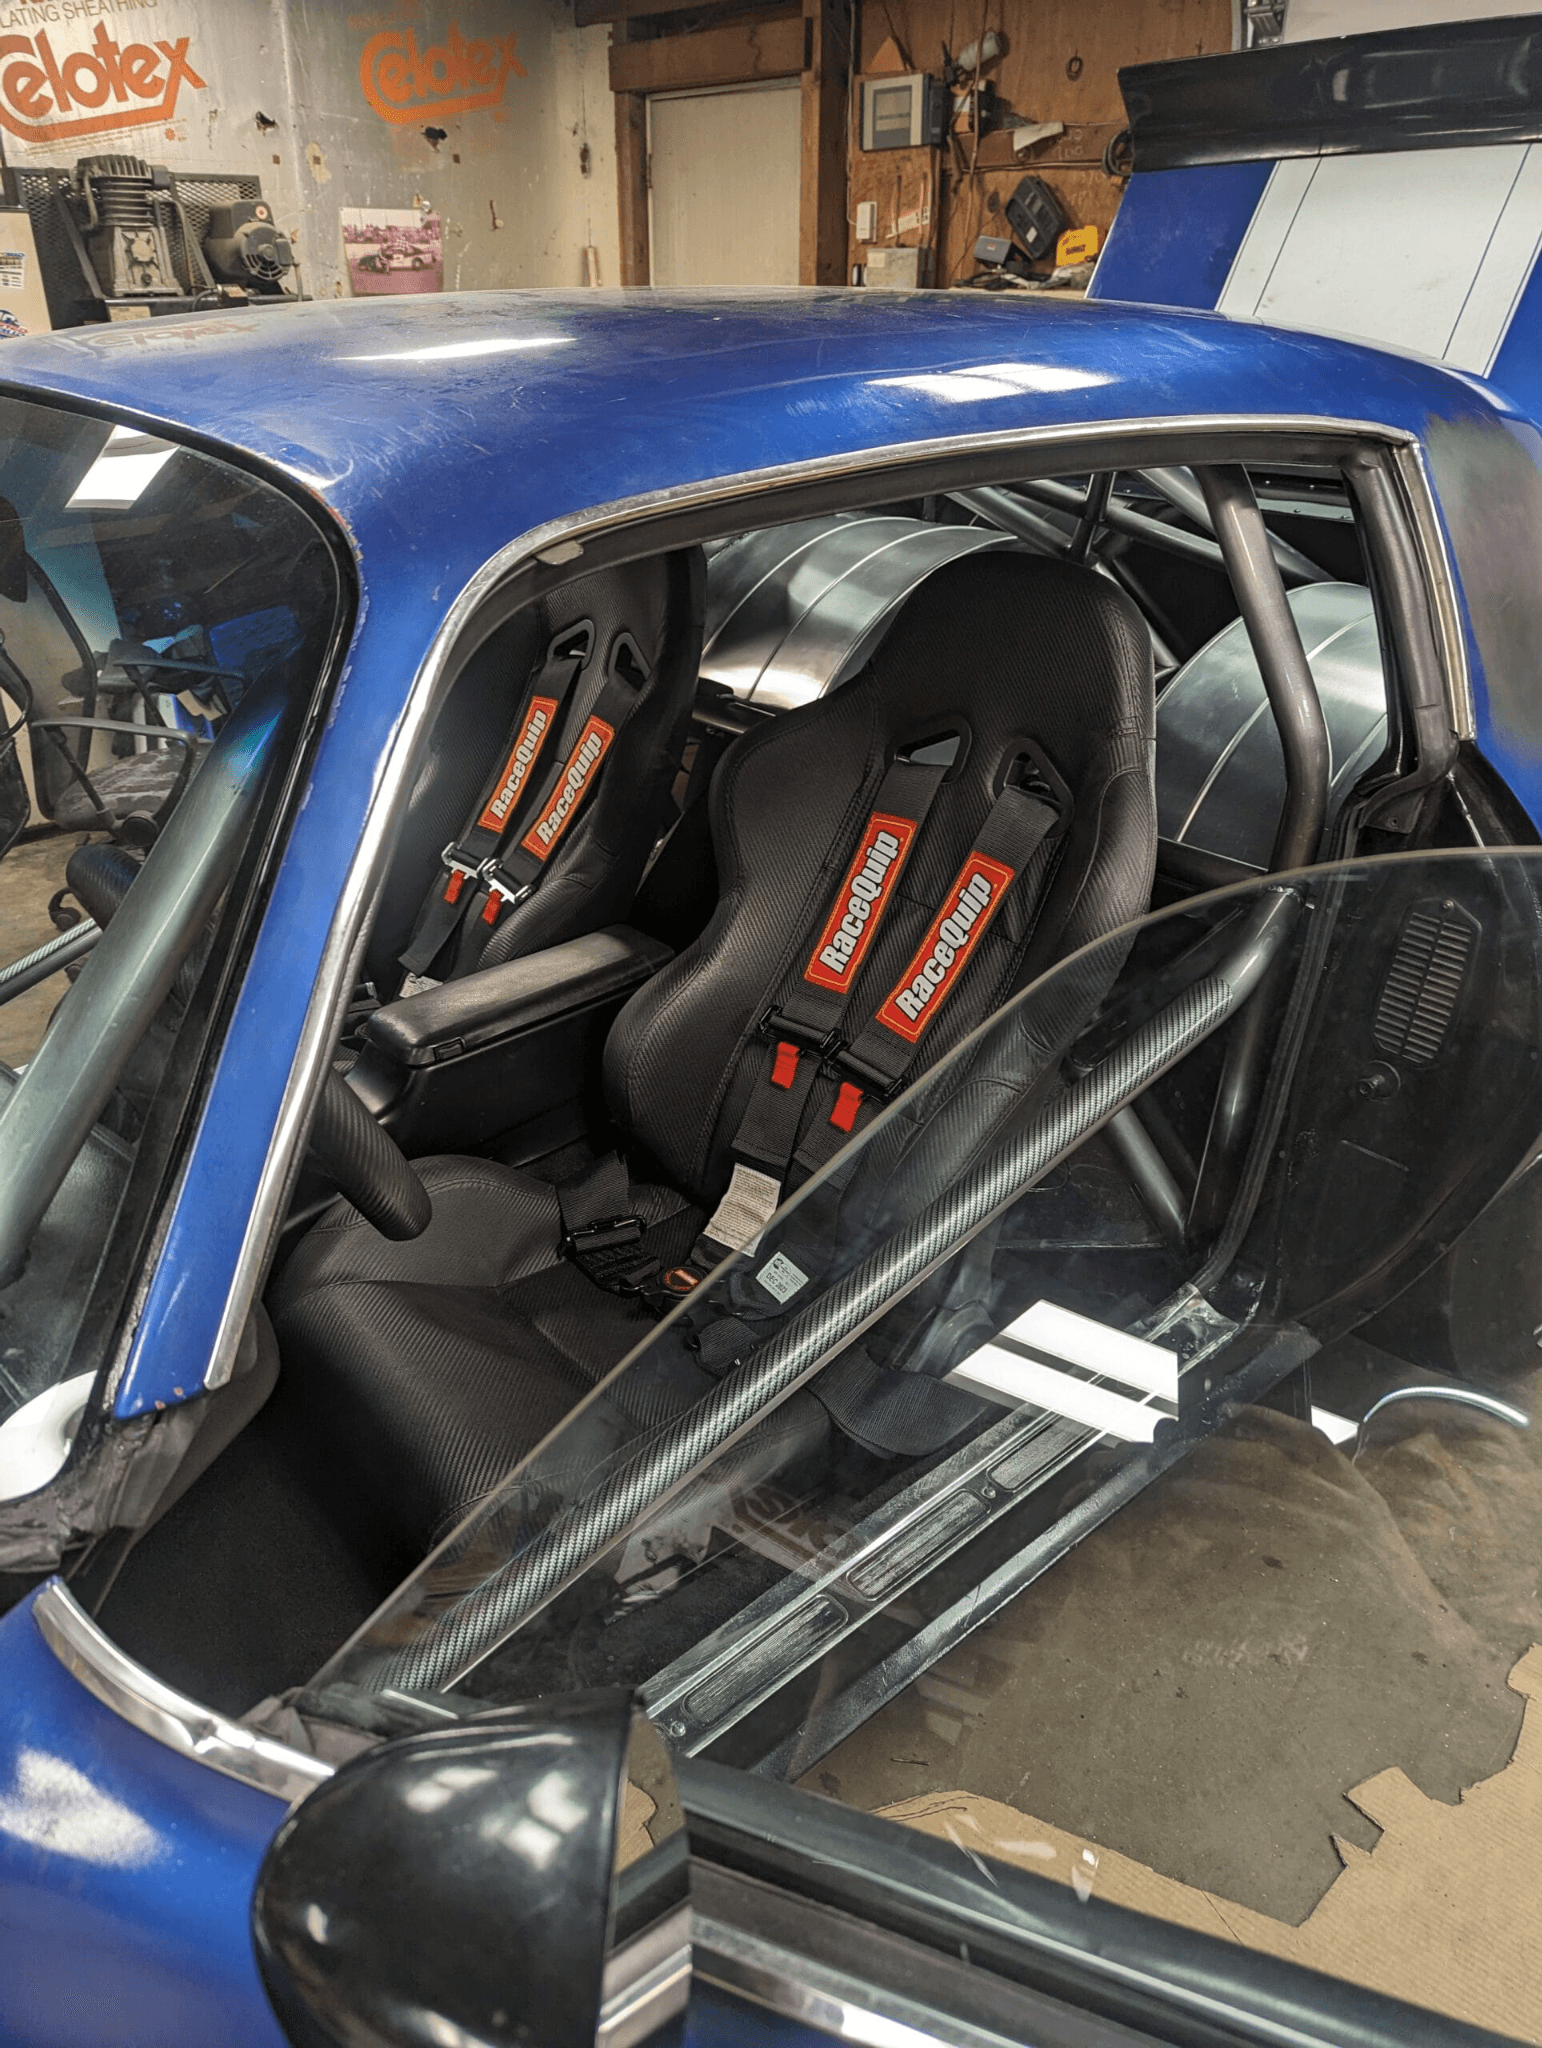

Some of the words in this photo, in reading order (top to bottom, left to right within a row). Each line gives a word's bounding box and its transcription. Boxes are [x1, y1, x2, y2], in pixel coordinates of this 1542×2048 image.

[360, 18, 529, 124] Celotex
[489, 709, 547, 819] RaceQuip
[536, 732, 603, 846] RaceQuip
[819, 831, 899, 974] RaceQuip
[896, 872, 992, 1021] RaceQuip
